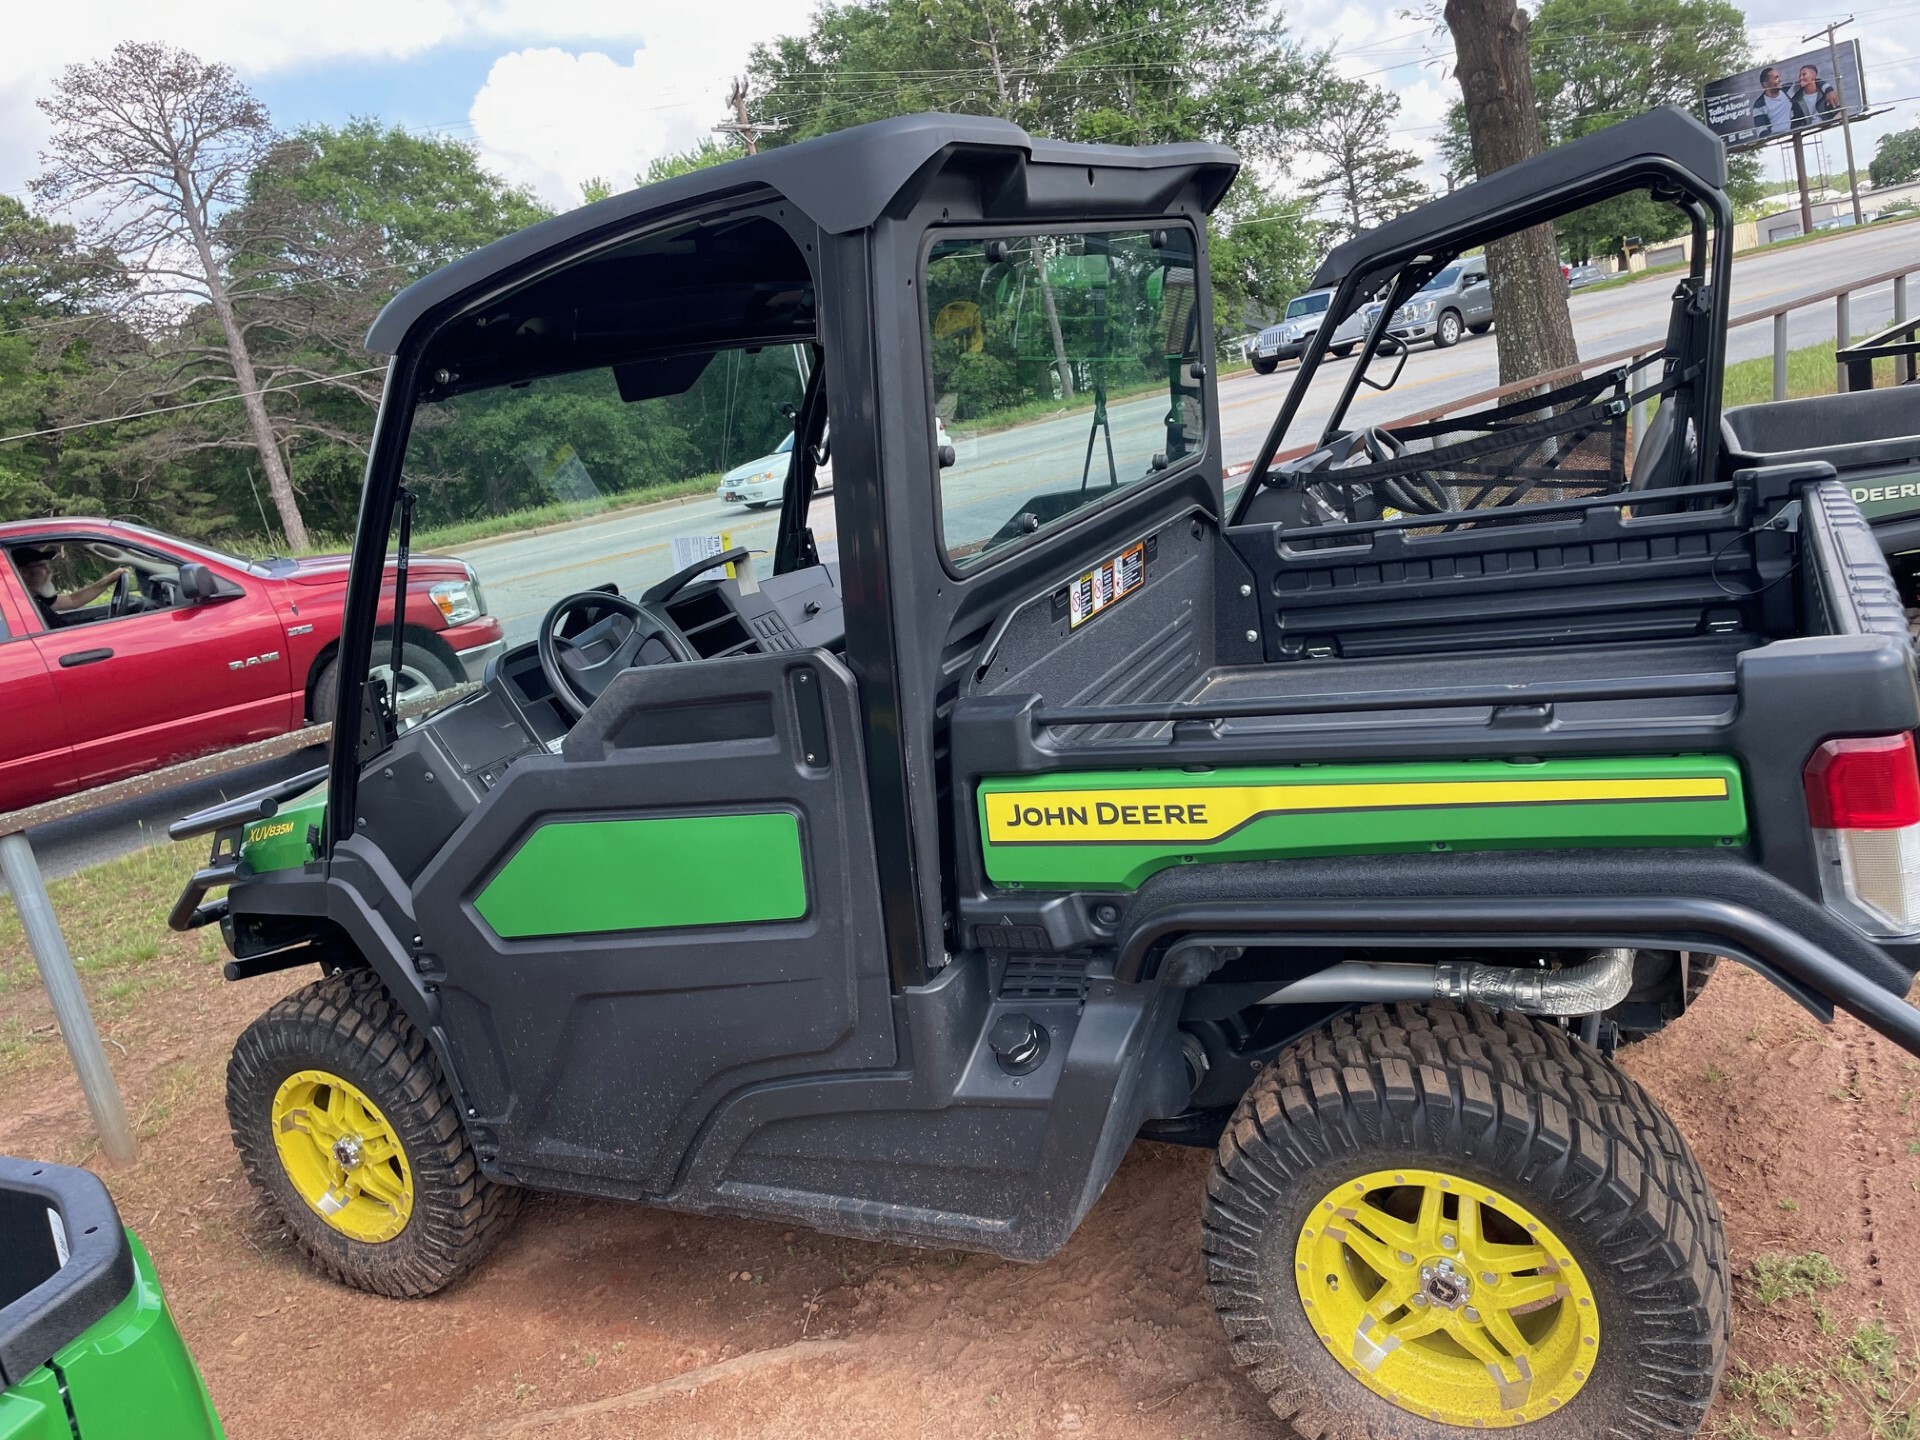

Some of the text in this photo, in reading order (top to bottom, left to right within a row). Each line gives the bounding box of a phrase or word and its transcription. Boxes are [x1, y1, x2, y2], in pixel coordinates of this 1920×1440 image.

[1709, 108, 1750, 124] Vaping.org
[1851, 482, 1920, 503] DEER
[228, 651, 279, 671] RAM
[1006, 802, 1208, 826] JOHN DEERE
[248, 821, 294, 842] XUV835M
